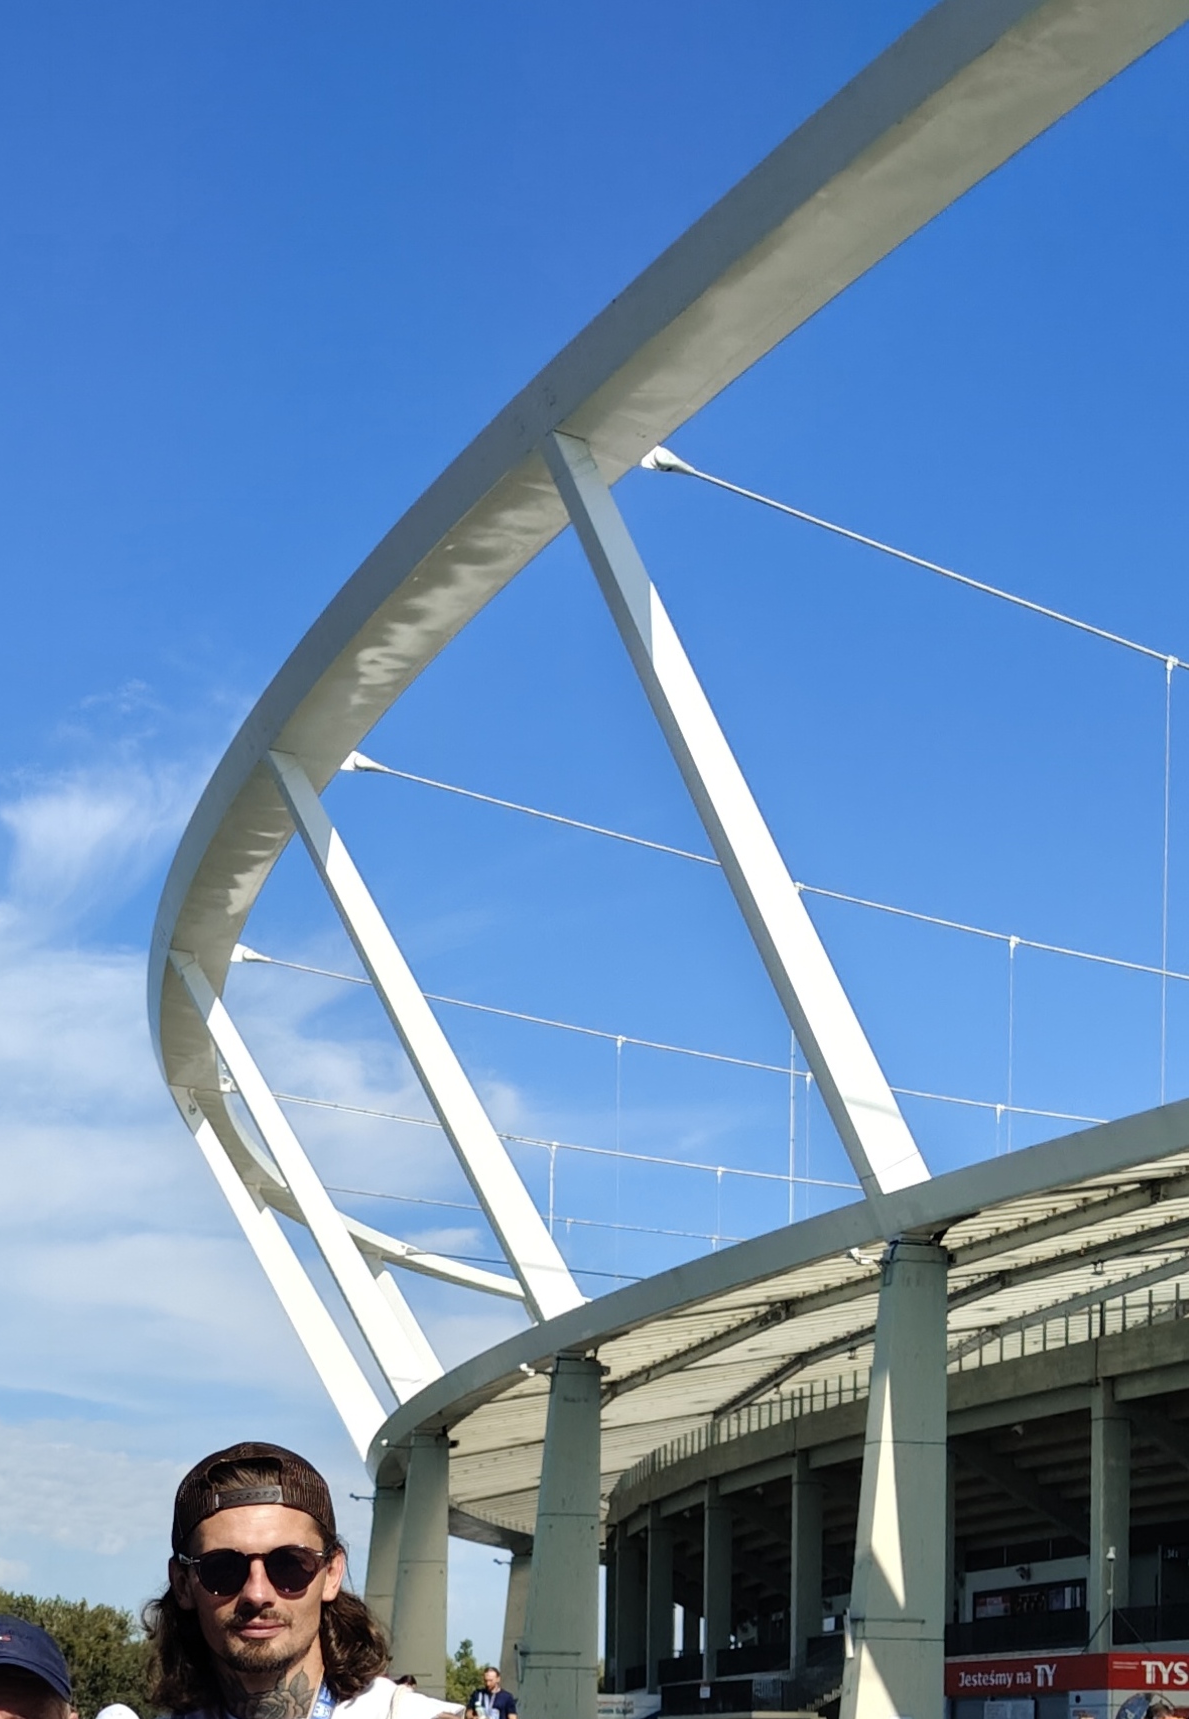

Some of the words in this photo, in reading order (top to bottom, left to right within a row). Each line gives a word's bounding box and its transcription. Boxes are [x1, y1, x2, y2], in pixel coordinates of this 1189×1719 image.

[959, 1670, 1014, 1688] Jesteśmy
[1016, 1671, 1032, 1684] na
[1034, 1664, 1057, 1687] TY
[1141, 1660, 1189, 1685] TYS
